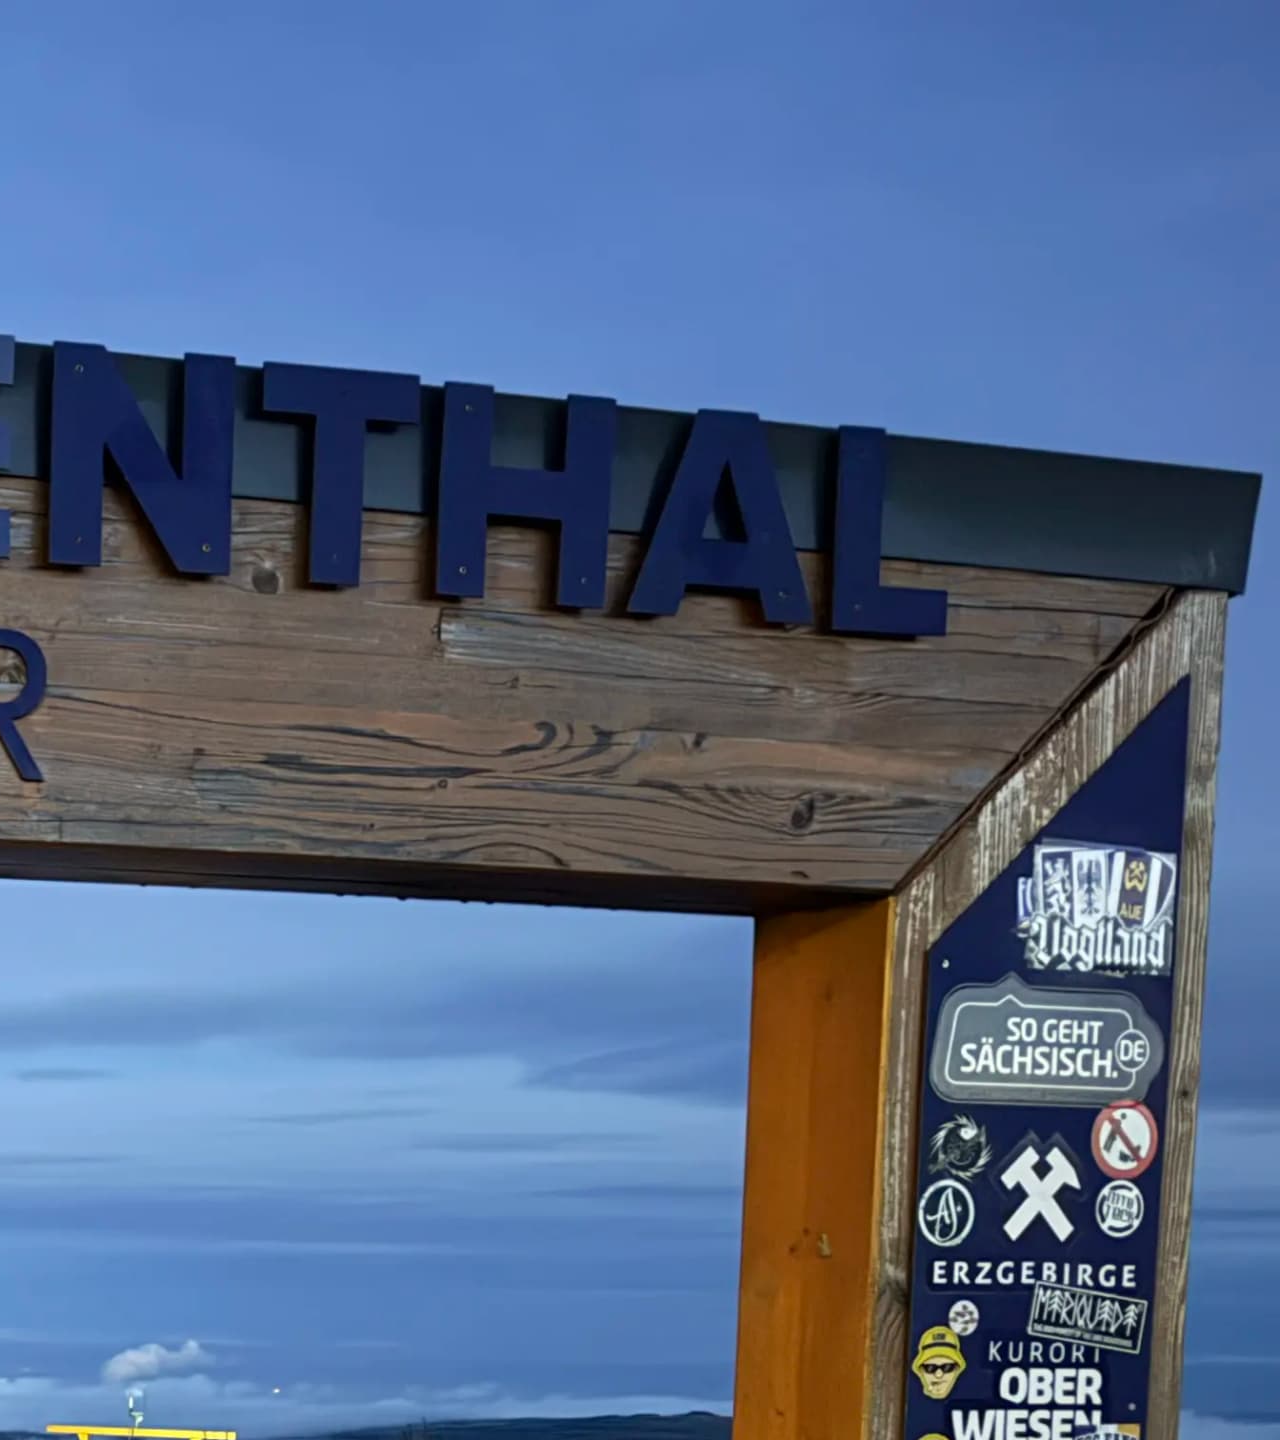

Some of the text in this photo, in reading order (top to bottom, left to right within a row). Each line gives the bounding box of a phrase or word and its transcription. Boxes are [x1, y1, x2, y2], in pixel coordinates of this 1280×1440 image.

[1006, 1016, 1104, 1044] SO GEHT
[959, 1036, 1119, 1079] SÄCHSISCH.
[1119, 1039, 1146, 1063] DE
[932, 1261, 1137, 1288] ERZGEBIRGE
[999, 1367, 1102, 1406] OBER
